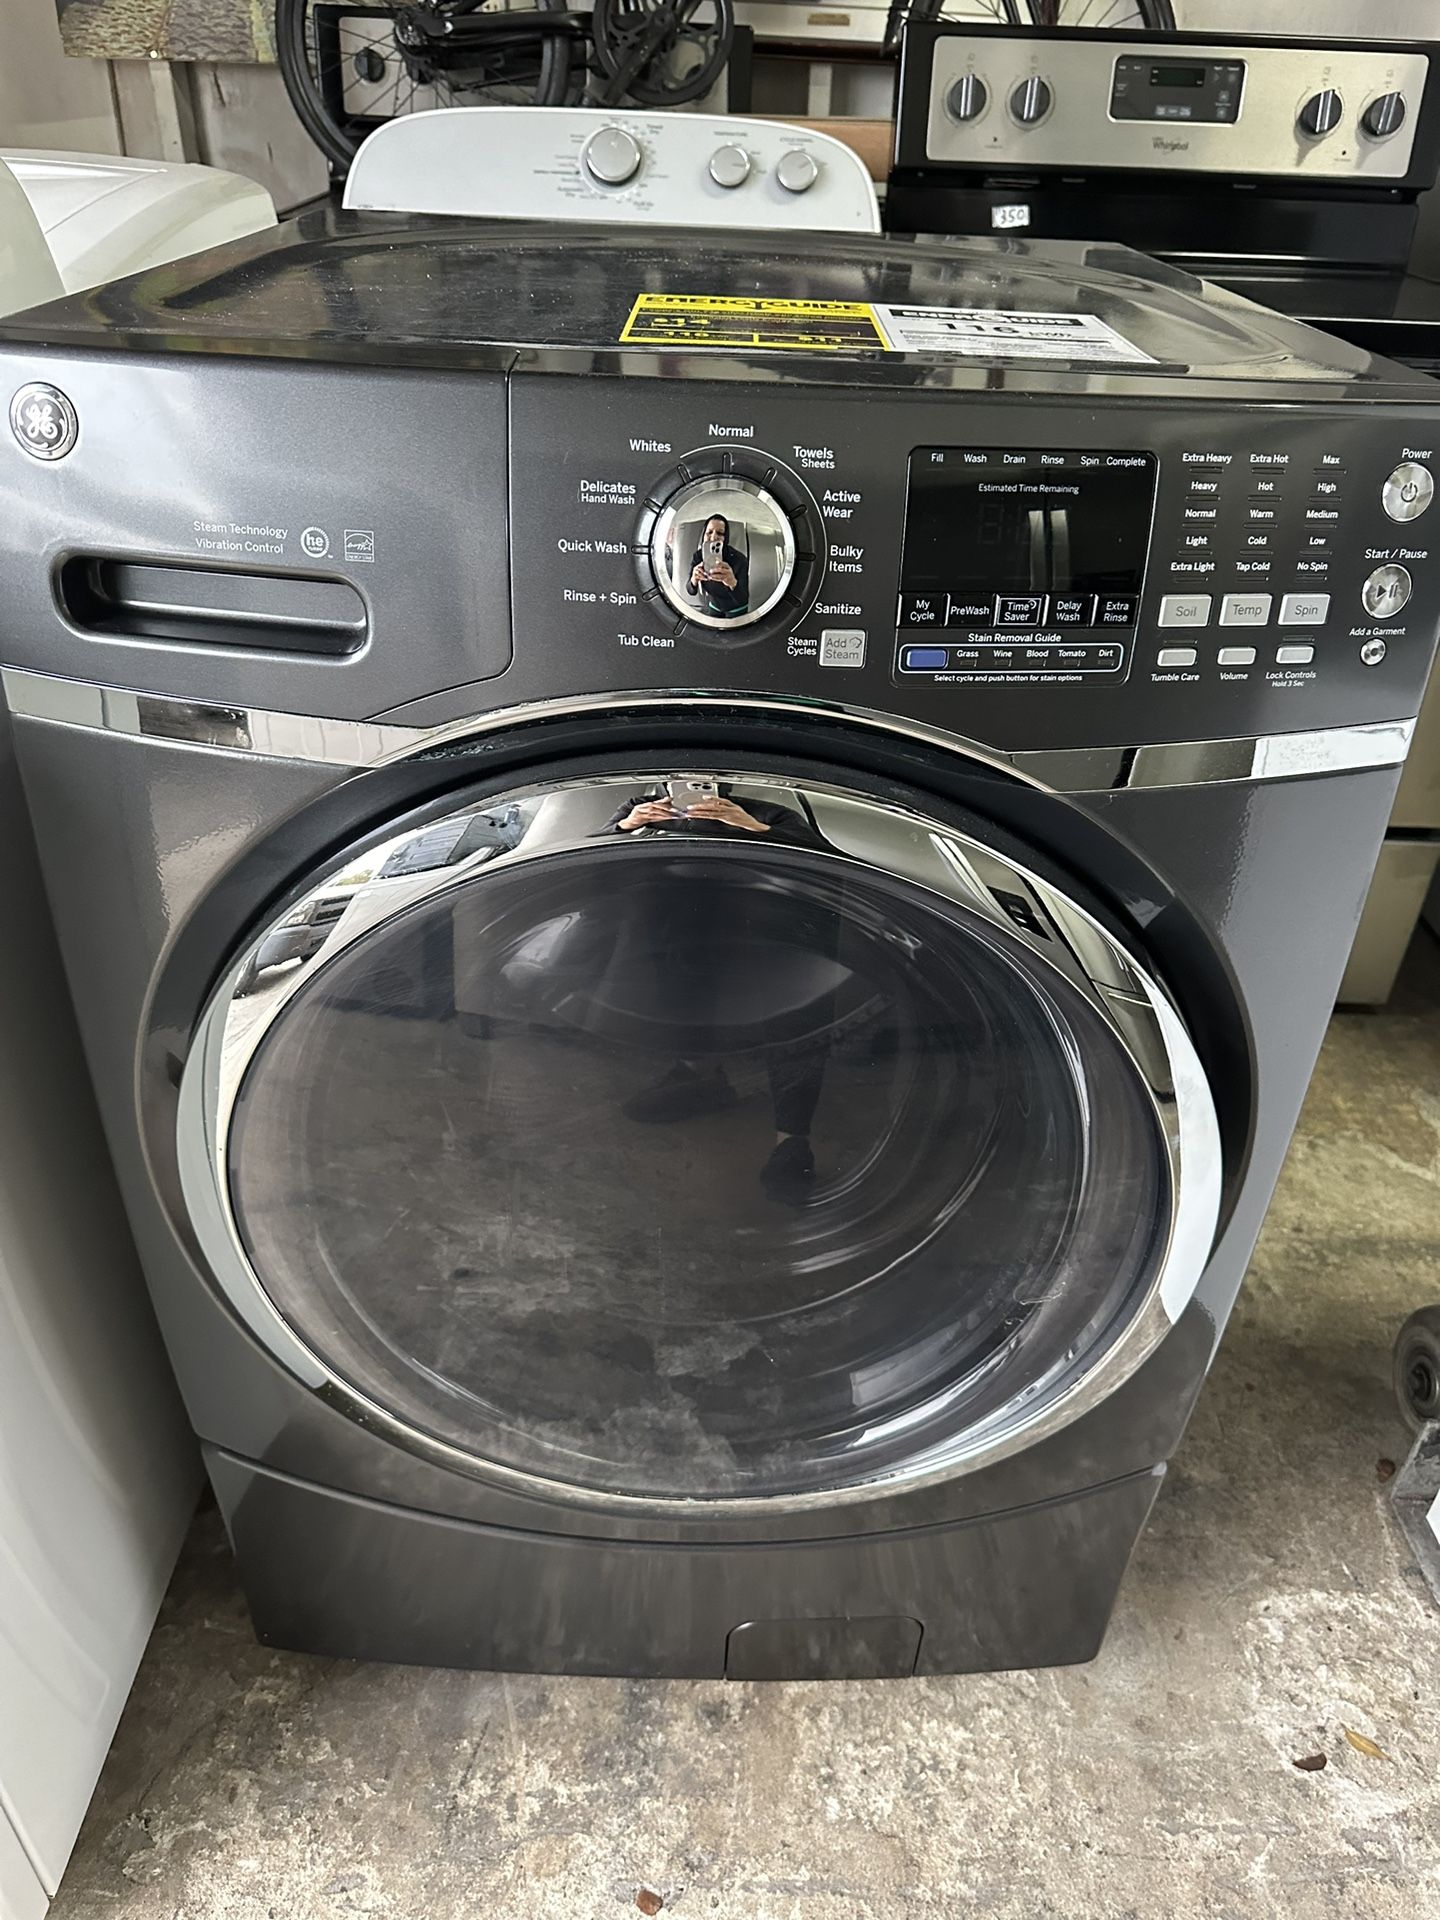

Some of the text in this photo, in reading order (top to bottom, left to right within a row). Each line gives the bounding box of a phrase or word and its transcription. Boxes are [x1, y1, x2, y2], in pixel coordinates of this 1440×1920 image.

[1000, 209, 1025, 225] 350
[938, 322, 1020, 334] 116
[709, 424, 754, 438] Normal
[629, 439, 671, 453] Whites
[793, 446, 834, 459] Towels
[931, 453, 943, 462] Fill
[1402, 449, 1432, 459] Power
[964, 454, 987, 463] Wash
[1003, 454, 1026, 464] Drain
[1041, 455, 1064, 465] Rinse
[1081, 456, 1099, 467] Spin
[1106, 457, 1146, 467] Complete
[1182, 453, 1232, 464] Extra Heavy
[1250, 454, 1289, 463] Extra Hot
[1323, 455, 1340, 464] Max
[801, 459, 835, 470] Sheets
[580, 480, 636, 494] Delicates
[978, 484, 1079, 494] Estimated Time Remaining
[1191, 481, 1217, 492] Heavy
[1258, 482, 1273, 491] Hot
[1317, 483, 1336, 493] High
[581, 494, 635, 504] Hand Wash
[823, 491, 861, 503] Active
[823, 507, 853, 518] Wear
[1185, 509, 1216, 518] Normal
[1250, 510, 1273, 519] Warm
[1306, 510, 1338, 519] Medium
[193, 521, 288, 539] Steam Technology
[306, 533, 324, 547] he
[1186, 536, 1207, 546] Light
[1248, 536, 1267, 545] Cold
[1309, 537, 1325, 545] Low
[195, 538, 283, 554] Vibration Control
[558, 539, 627, 554] Quick Wash
[830, 546, 863, 559] Bulky
[1365, 549, 1427, 559] Start / Pause
[829, 561, 863, 573] Items
[1171, 563, 1215, 572] Extra Light
[1236, 563, 1270, 572] Tap Cold
[1297, 562, 1328, 572] No Spin
[563, 590, 637, 605] Rinse + Spin
[815, 603, 862, 615] Sanitize
[916, 601, 930, 611] My
[951, 606, 989, 615] PreWash
[1007, 602, 1029, 611] Time
[1057, 601, 1082, 612] Delay
[1106, 602, 1129, 611] Extra
[1233, 604, 1262, 617] Temp
[1295, 604, 1318, 617] Spin
[910, 611, 935, 621] Cycle
[1004, 612, 1029, 621] Saver
[1056, 612, 1080, 621] Wash
[1176, 606, 1197, 617] Soil
[1104, 613, 1128, 621] Rinse
[1349, 627, 1364, 636] Add
[1371, 627, 1405, 636] Garment
[618, 635, 675, 648] Tub Clean
[787, 637, 817, 647] Steam
[968, 633, 1062, 643] Stain Removal Guide
[826, 638, 847, 649] Add
[787, 646, 817, 656] Cycles
[825, 650, 859, 660] Steam
[957, 649, 979, 658] Grass
[993, 649, 1012, 658] Wine
[1026, 649, 1049, 658] Blood
[1058, 649, 1086, 658] Tomato
[1098, 649, 1113, 657] Dirt
[934, 674, 1082, 683] Select cycle and push button for stain options
[1151, 673, 1179, 682] Tumble
[1220, 672, 1248, 680] Volume
[1266, 671, 1316, 679] Lock Controls
